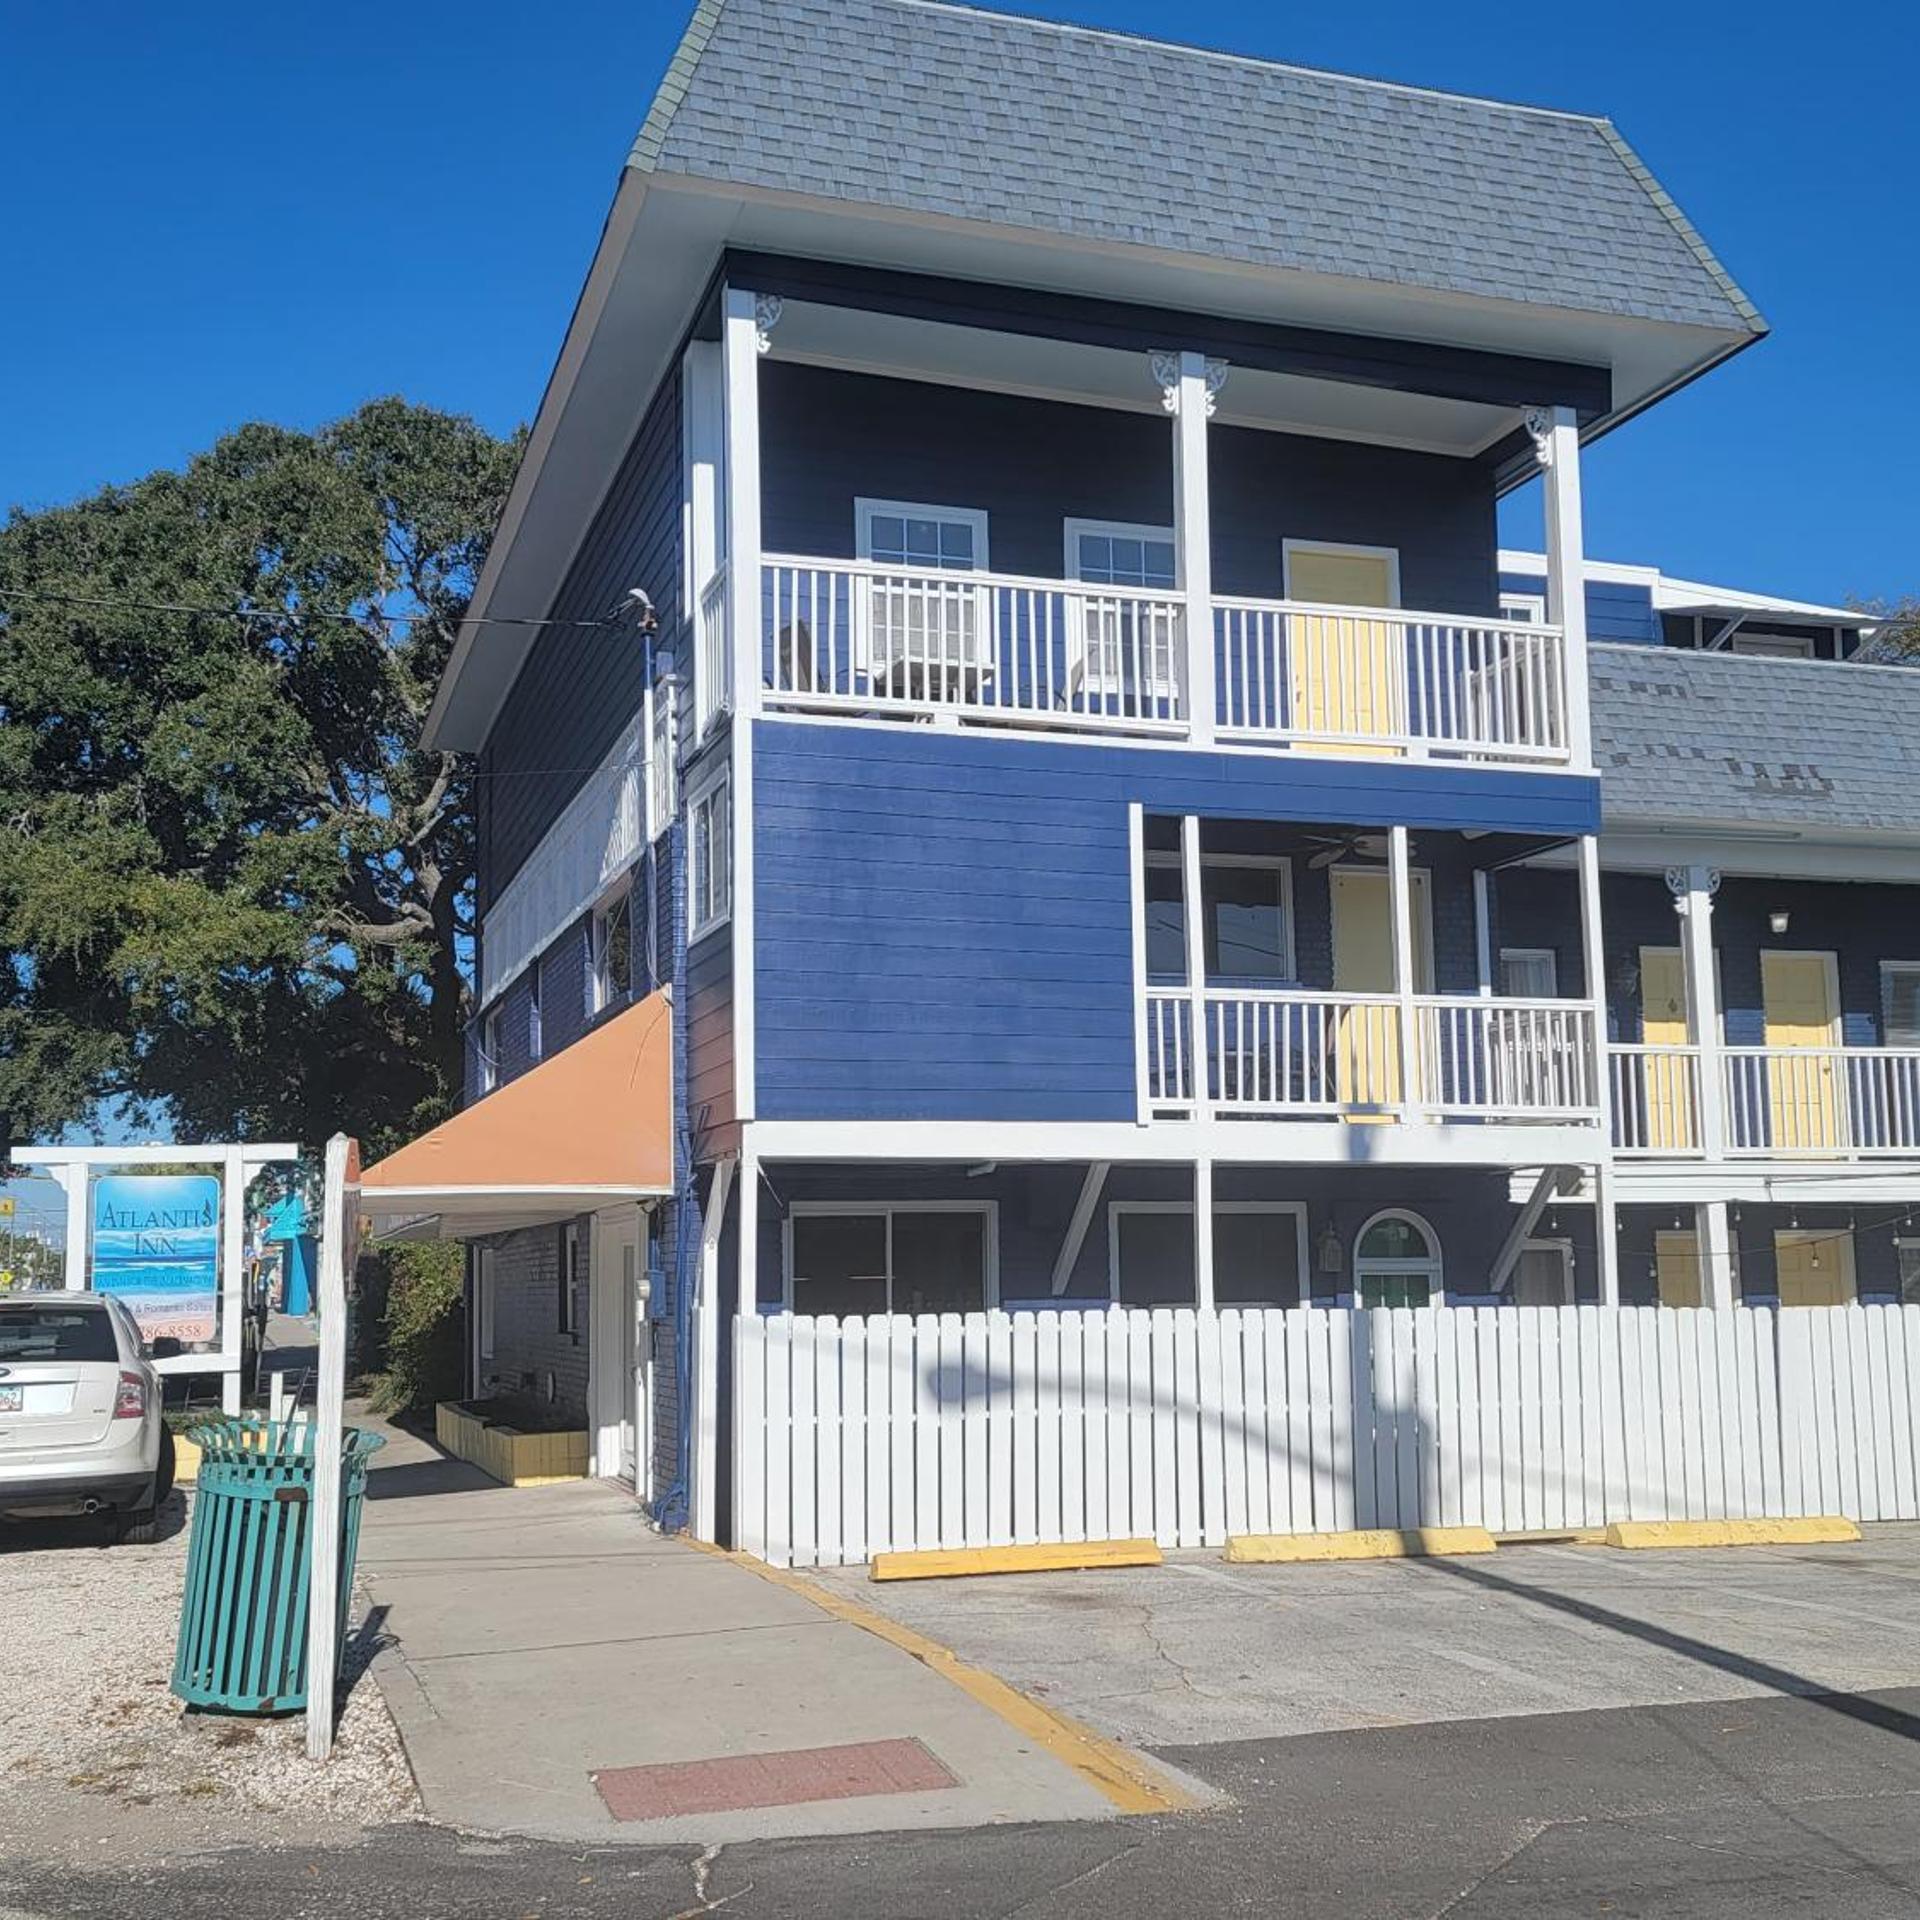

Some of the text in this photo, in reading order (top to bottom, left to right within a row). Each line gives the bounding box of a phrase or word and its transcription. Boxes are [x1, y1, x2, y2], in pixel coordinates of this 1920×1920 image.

[101, 1200, 213, 1228] ATLANTIS
[135, 1233, 178, 1255] INN
[142, 1325, 201, 1338] 86-8558
